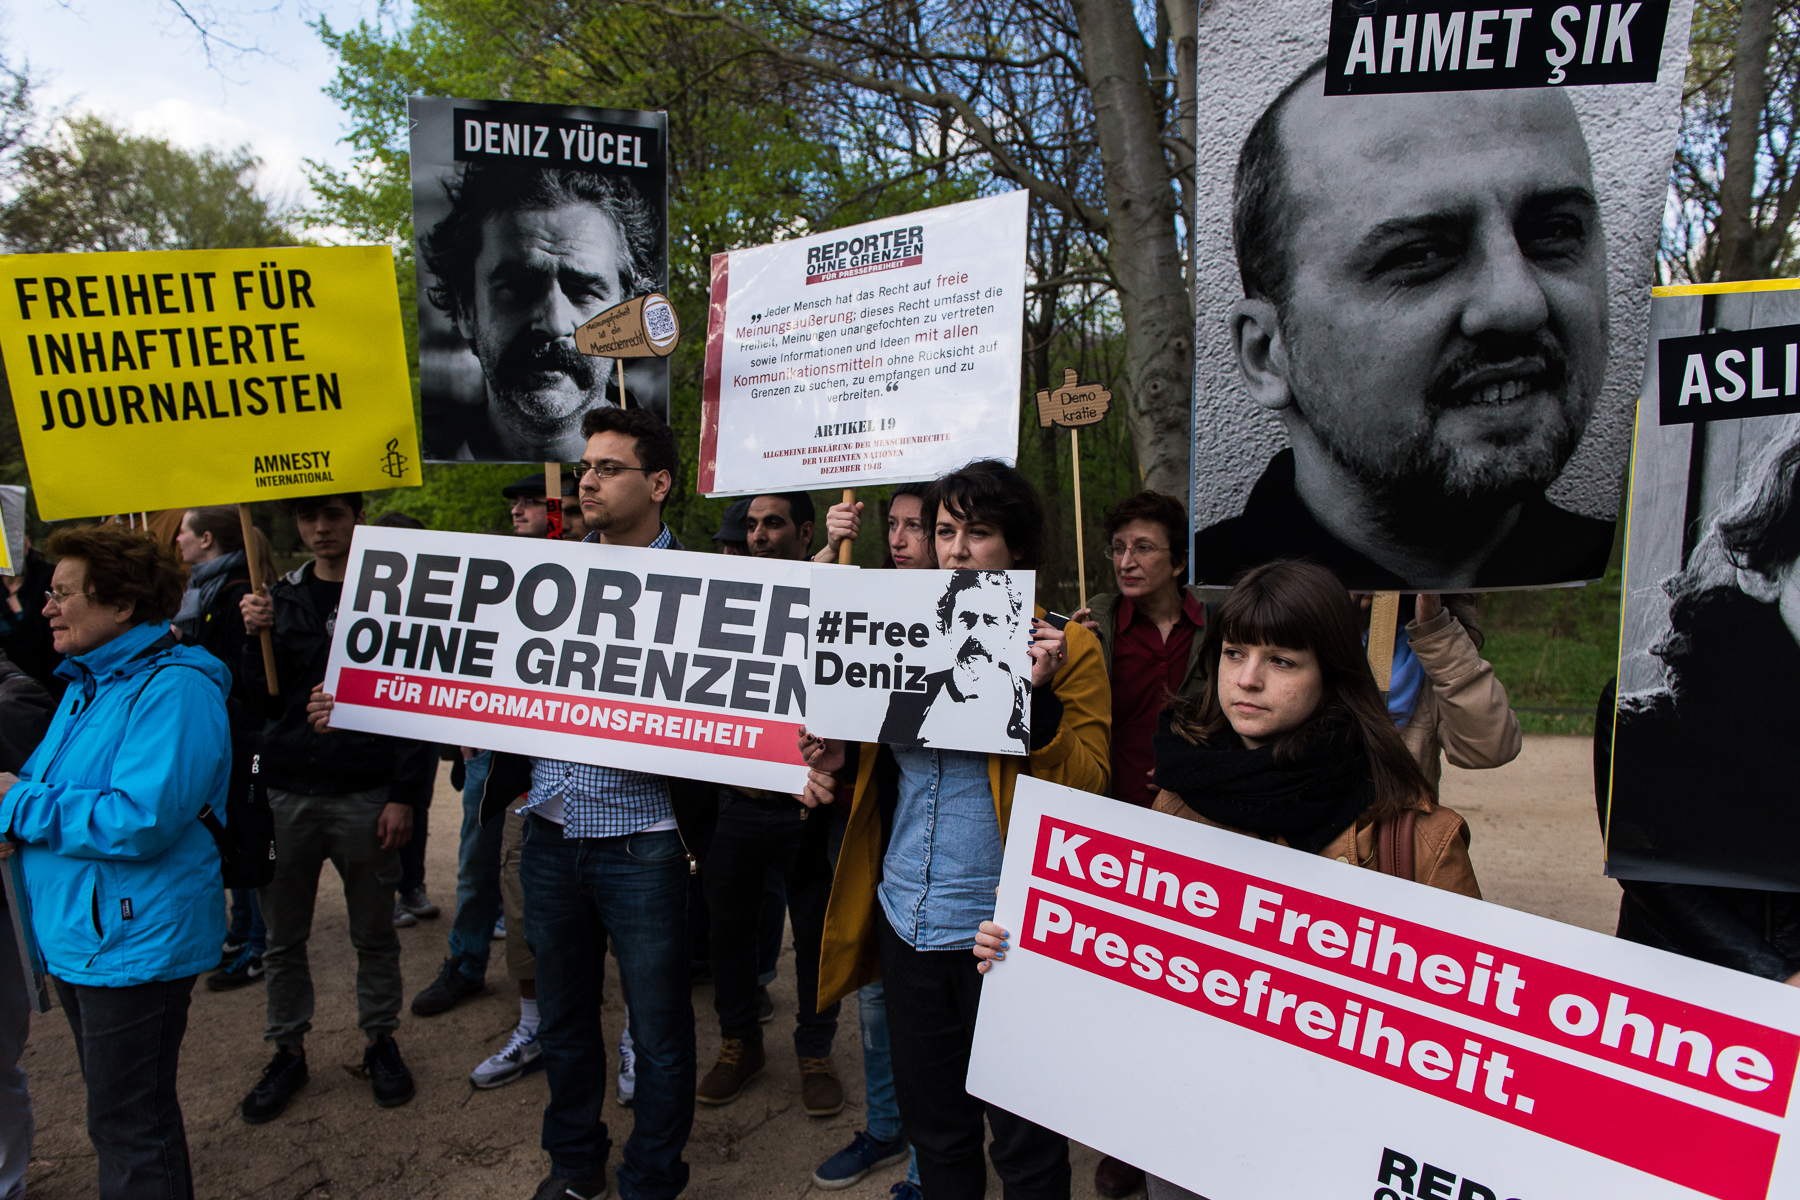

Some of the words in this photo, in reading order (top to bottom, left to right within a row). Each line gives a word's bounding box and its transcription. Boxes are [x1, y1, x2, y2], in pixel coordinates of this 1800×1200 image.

[1344, 8, 1533, 75] AHMET
[1545, 3, 1643, 84] ŞIK
[465, 119, 549, 158] DENIZ
[559, 124, 648, 168] YÜCEL
[807, 225, 923, 264] REPORTER
[807, 258, 847, 275] OHNE
[850, 243, 923, 267] GRENZEN
[822, 272, 837, 281] FÜR
[839, 260, 905, 278] PRESSEFREIHEIT
[14, 272, 216, 320] FREIHEIT
[233, 262, 315, 311] FÜR
[794, 297, 832, 312] Mensch
[836, 293, 853, 305] hat
[856, 290, 875, 301] das
[879, 283, 909, 297] Recht
[913, 279, 931, 292] auf
[937, 272, 969, 288] freie
[860, 305, 894, 319] dieses
[899, 298, 930, 312] Recht
[934, 290, 980, 307] umfasst
[985, 287, 1003, 298] die
[586, 305, 630, 331] Meinungsfreiheit
[611, 326, 622, 335] ein
[740, 338, 778, 352] Freiheit,
[782, 329, 837, 346] Meinungen
[840, 315, 920, 338] unangefochten
[924, 314, 937, 324] zu
[941, 304, 994, 321] vertreten
[27, 322, 305, 376] INHAFTIERTE
[590, 330, 645, 354] Menschenrecht
[750, 355, 777, 368] sowie
[780, 345, 852, 363] Informationen
[856, 339, 876, 352] und
[881, 336, 910, 348] Ideen
[915, 328, 938, 343] mit
[943, 325, 978, 340] allen
[734, 356, 883, 388] Kommunikationsmitteln
[887, 355, 914, 366] ohne
[918, 345, 975, 362] Rücksicht
[979, 340, 998, 354] auf
[751, 385, 790, 399] Grenzen
[794, 384, 805, 393] zu
[809, 378, 849, 392] suchen,
[853, 376, 865, 386] zu
[868, 366, 931, 384] empfangen
[934, 362, 957, 375] und
[960, 362, 975, 372] zu
[1678, 343, 1798, 406] ASLI
[40, 372, 342, 431] JOURNALISTEN
[1061, 392, 1096, 405] Demo
[1062, 406, 1098, 422] kratie
[762, 447, 807, 459] ALLGEMEINE
[807, 442, 854, 455] ERKLÄRUNG
[854, 441, 871, 450] DER
[873, 433, 951, 448] MENSCHENRECHTE
[814, 420, 875, 438] ARTIKEL
[880, 417, 896, 431] 19
[253, 451, 331, 474] AMNESTY
[802, 458, 817, 466] DER
[819, 452, 861, 464] VEREINTEN
[863, 449, 904, 460] NATIONEN
[820, 464, 861, 475] DEZEMBER
[863, 462, 882, 471] 1948
[255, 471, 334, 488] INTERNATIONAL
[353, 549, 810, 659] REPORTER
[815, 611, 930, 648] #Free
[346, 617, 499, 679] OHNE
[516, 637, 807, 718] GRENZEN
[814, 651, 926, 692] Deniz
[374, 676, 422, 704] FÜR
[428, 684, 764, 750] INFORMATIONSFREIHEIT
[1046, 827, 1220, 918] Keine
[1239, 884, 1526, 1017] Freiheit
[1548, 992, 1774, 1092] ohne
[1032, 898, 1535, 1114] Pressefreiheit.
